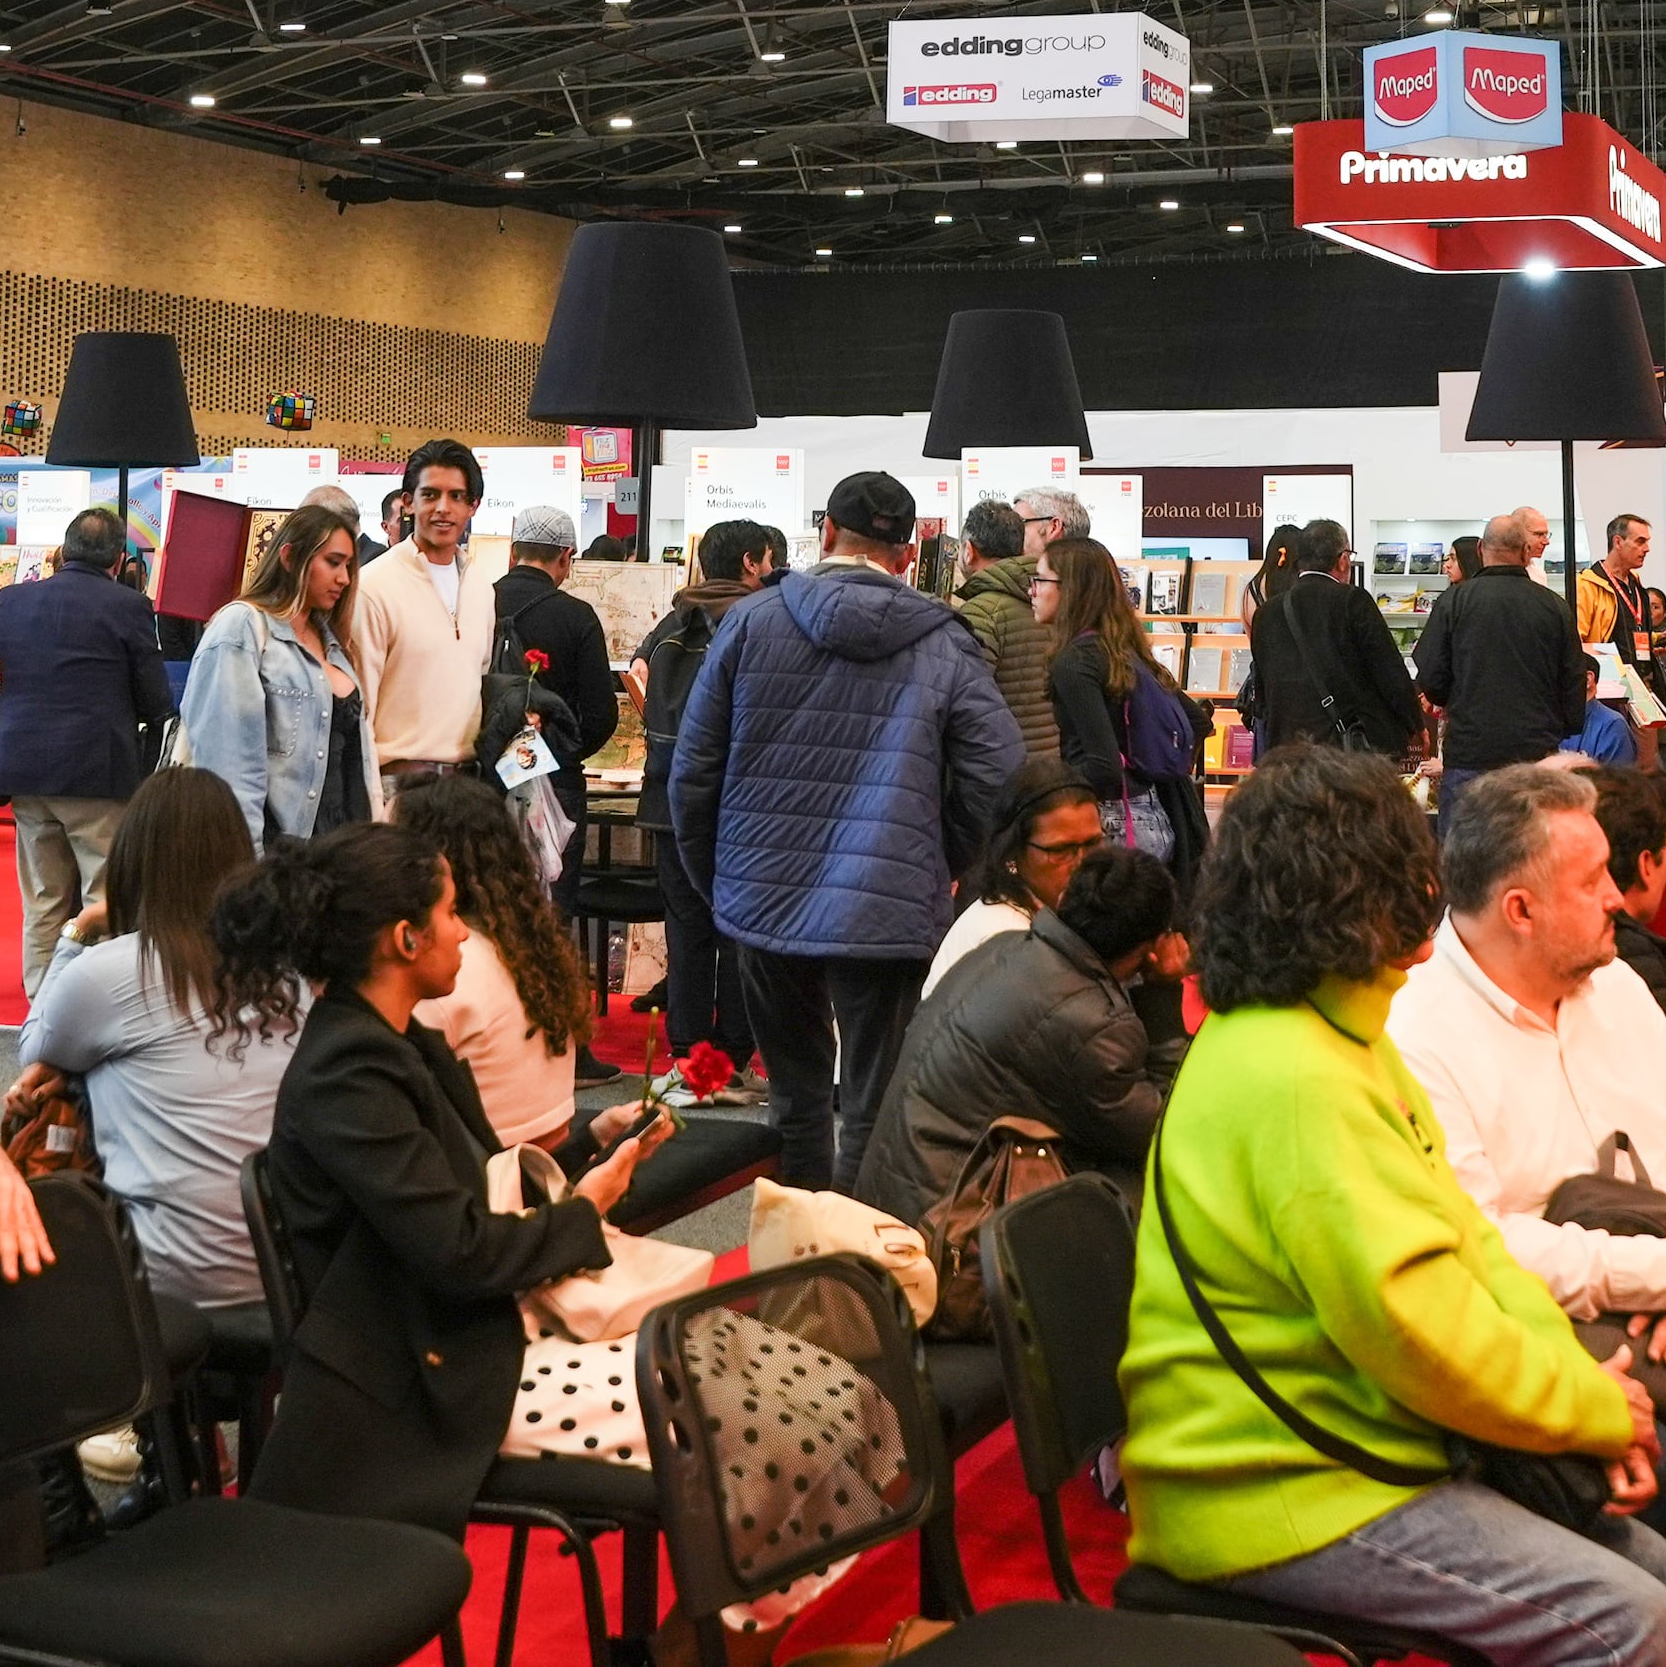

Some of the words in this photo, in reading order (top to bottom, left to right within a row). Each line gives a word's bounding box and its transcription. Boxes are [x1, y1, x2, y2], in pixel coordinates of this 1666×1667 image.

[1379, 70, 1433, 99] Maped
[1471, 67, 1542, 97] Maped
[921, 85, 993, 103] edding
[1022, 85, 1102, 103] Legamaster
[1150, 80, 1184, 116] edding
[1340, 151, 1527, 184] Primavera
[707, 484, 734, 495] Orbis
[978, 489, 1007, 500] Orbis
[246, 496, 272, 506] Eikon
[487, 498, 515, 508] Eikon
[707, 499, 767, 509] Mediaevalis
[1144, 502, 1201, 518] zolana
[1205, 502, 1231, 518] del
[1235, 502, 1263, 518] Lib
[1276, 514, 1298, 522] CEPC
